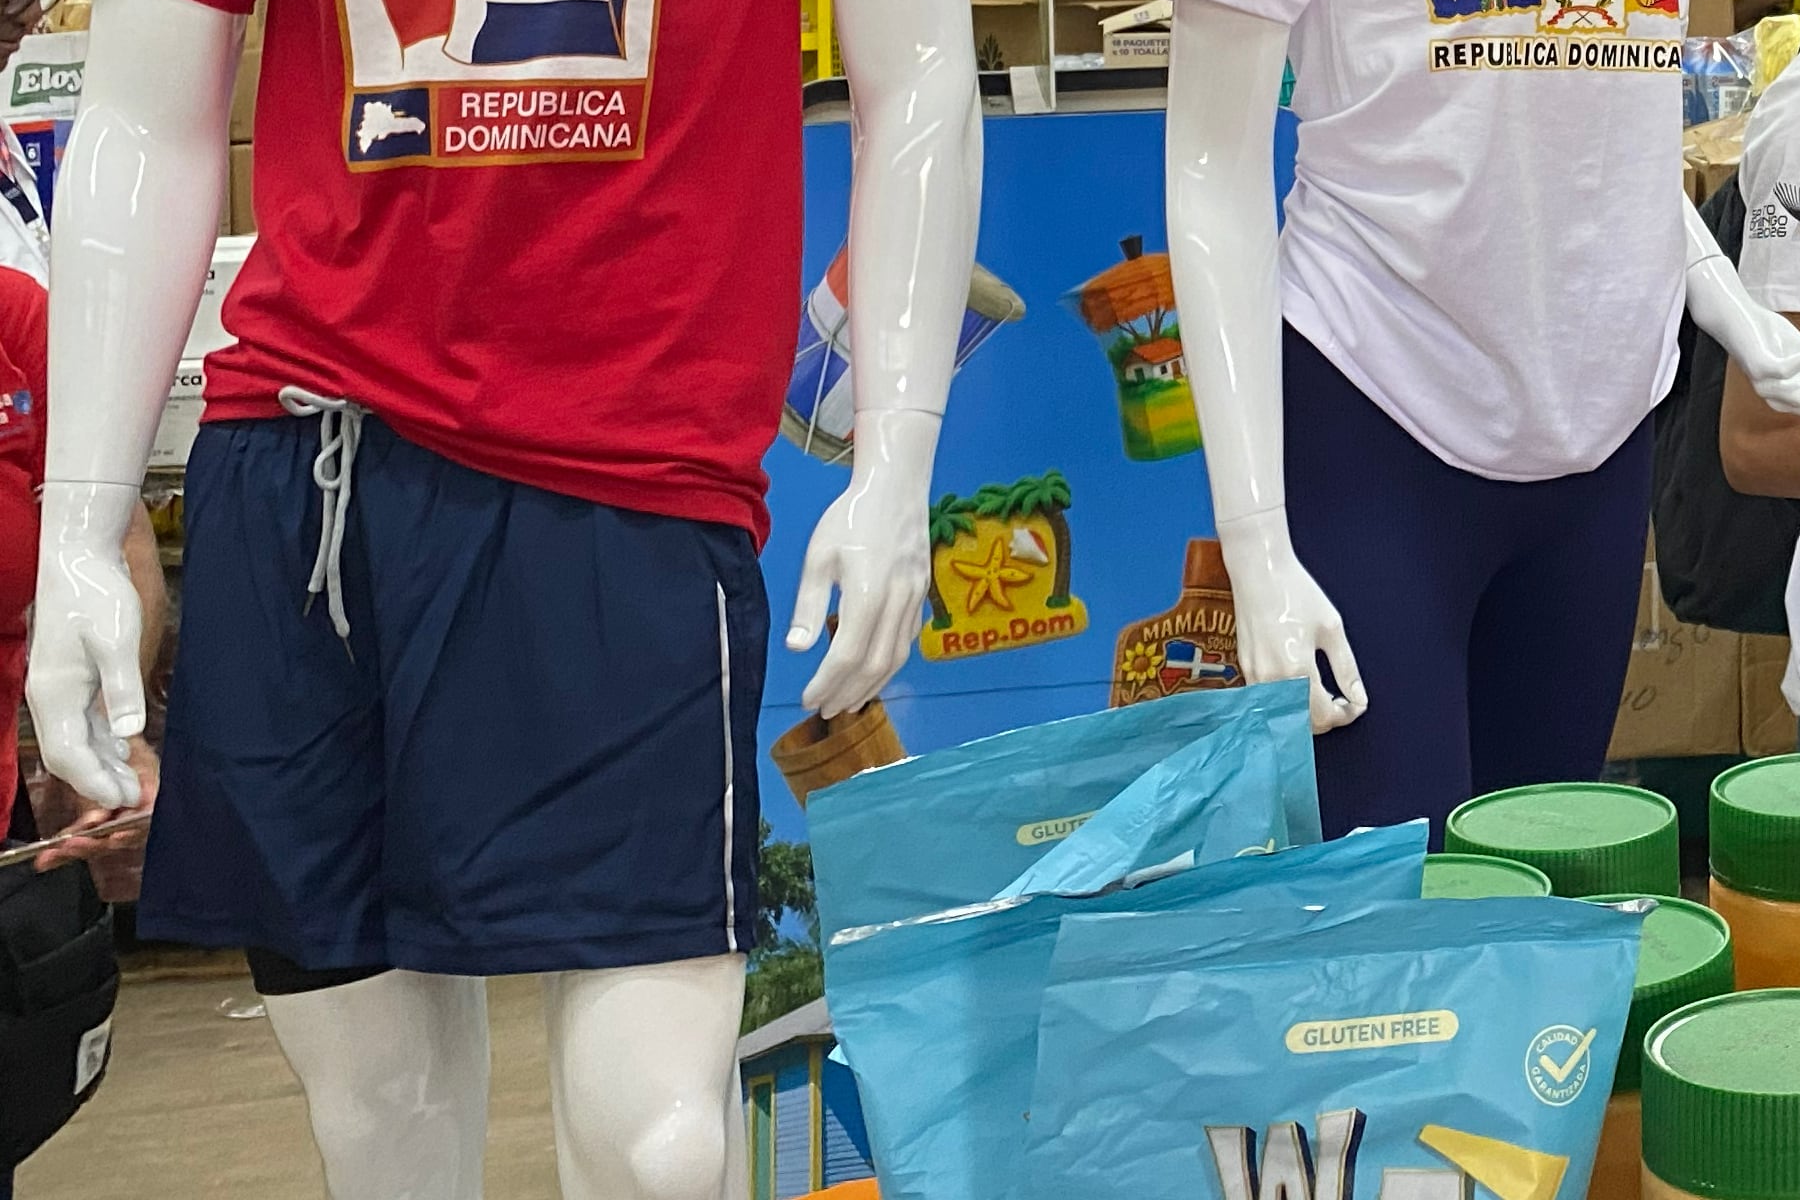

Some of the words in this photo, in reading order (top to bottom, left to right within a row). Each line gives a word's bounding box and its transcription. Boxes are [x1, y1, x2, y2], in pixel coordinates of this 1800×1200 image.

[1434, 41, 1559, 69] REPUBLICA
[461, 90, 626, 119] REPUBLICA
[445, 122, 632, 153] DOMINICANA
[1303, 1023, 1386, 1047] GLUTEN
[1390, 1017, 1440, 1038] FREE
[1536, 1031, 1578, 1053] CALIDAD
[1531, 1064, 1587, 1098] GARANTIZADA
